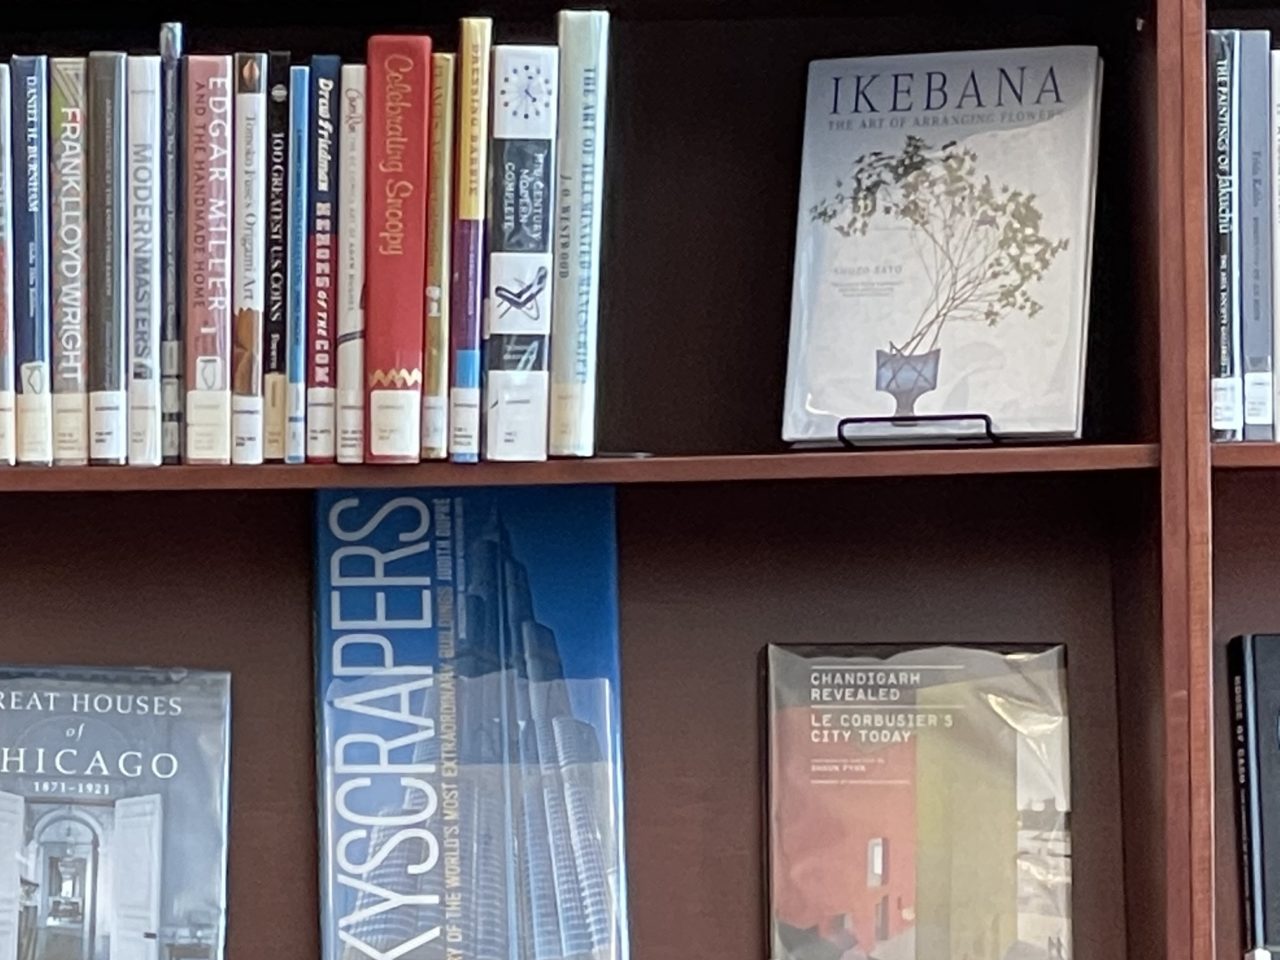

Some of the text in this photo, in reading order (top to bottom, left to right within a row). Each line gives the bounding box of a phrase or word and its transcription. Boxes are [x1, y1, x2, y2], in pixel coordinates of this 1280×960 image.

[830, 65, 1064, 115] IKEBANA
[243, 116, 257, 166] Tomoko
[379, 55, 413, 255] Celebrating Snoopy
[193, 81, 206, 308] AND THE HANDMADE HOME
[208, 76, 226, 310] EDGAR MILLER
[61, 107, 81, 383] FRANK LLOYD WRIGHT
[241, 213, 258, 272] Origami
[243, 276, 256, 300] Art
[438, 587, 454, 658] BUILDINGS
[811, 673, 921, 685] CHANDIGARH
[811, 688, 900, 701] REVEALED
[72, 694, 183, 715] HOUSES
[440, 664, 457, 777] EXTRAORDINARY
[811, 714, 953, 727] LE CORBUSIER'S
[66, 724, 84, 740] of
[811, 730, 911, 742] CITY TODAY
[441, 784, 458, 820] MOST
[444, 827, 460, 887] WORLD'S
[446, 892, 462, 919] THE
[447, 925, 462, 941] OF
